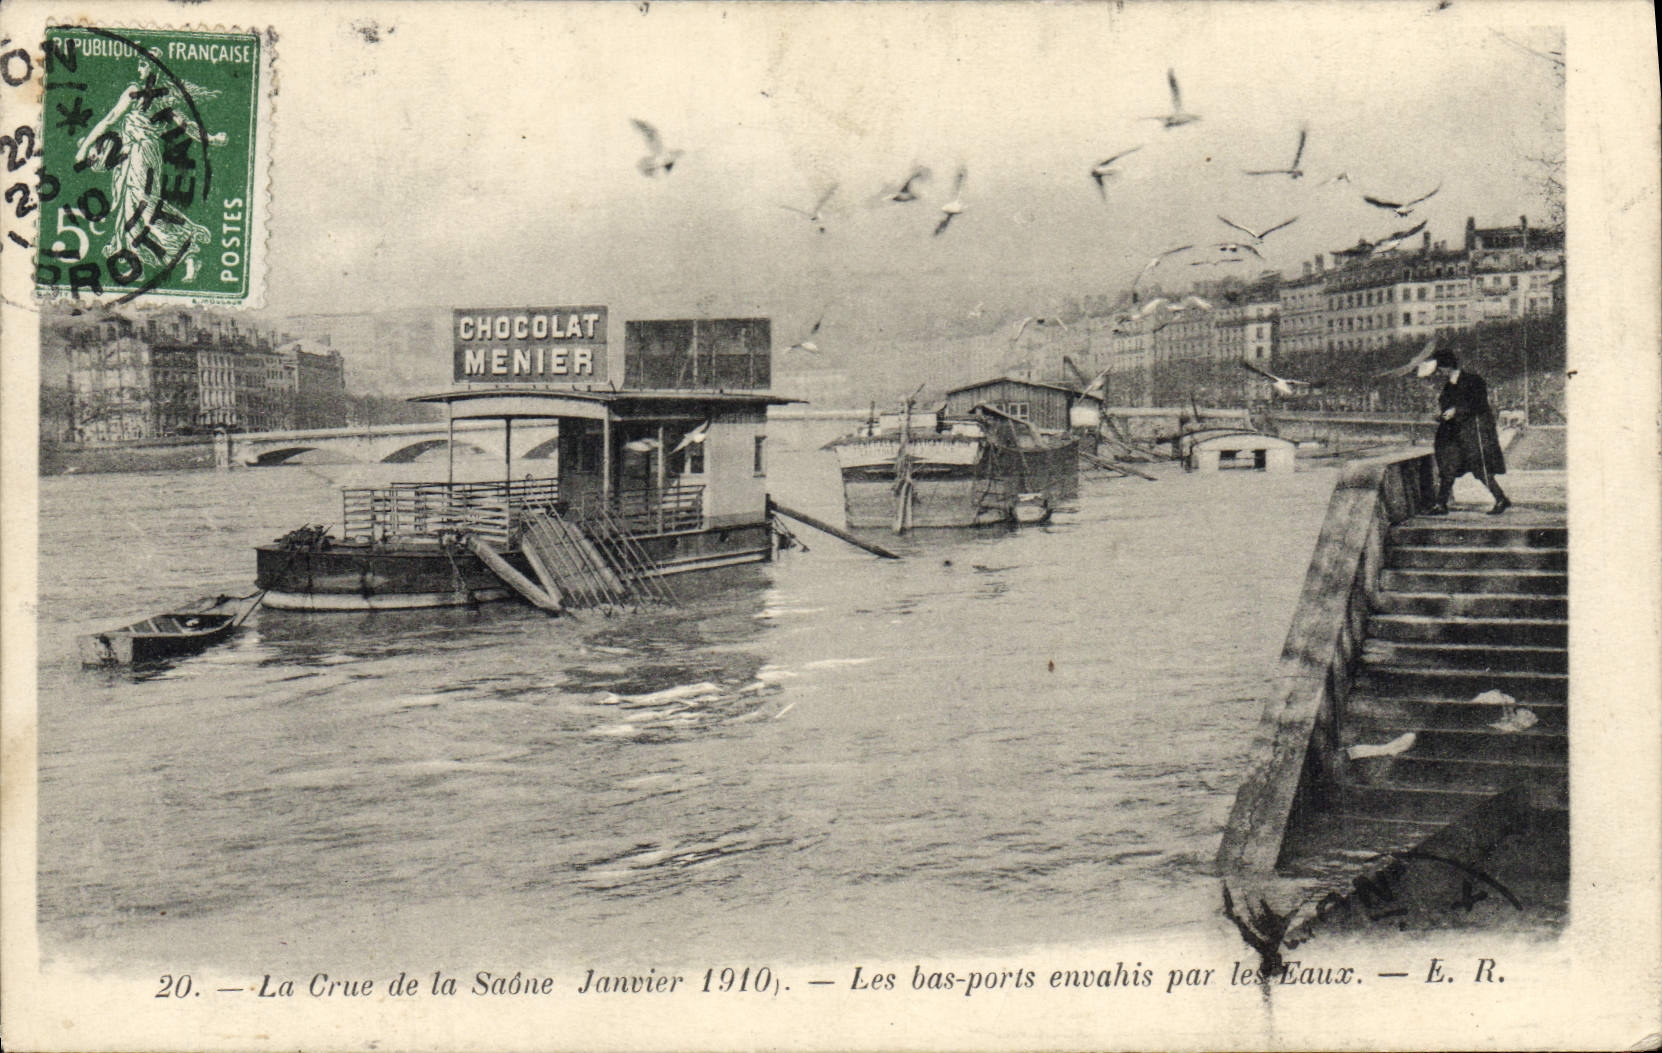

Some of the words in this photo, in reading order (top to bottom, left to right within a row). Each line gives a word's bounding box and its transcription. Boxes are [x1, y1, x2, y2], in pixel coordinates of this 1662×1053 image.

[168, 42, 250, 64] FRANÇAISE
[221, 197, 243, 282] POSTES
[459, 314, 599, 341] CHOCOLAT
[465, 348, 594, 376] MENIER
